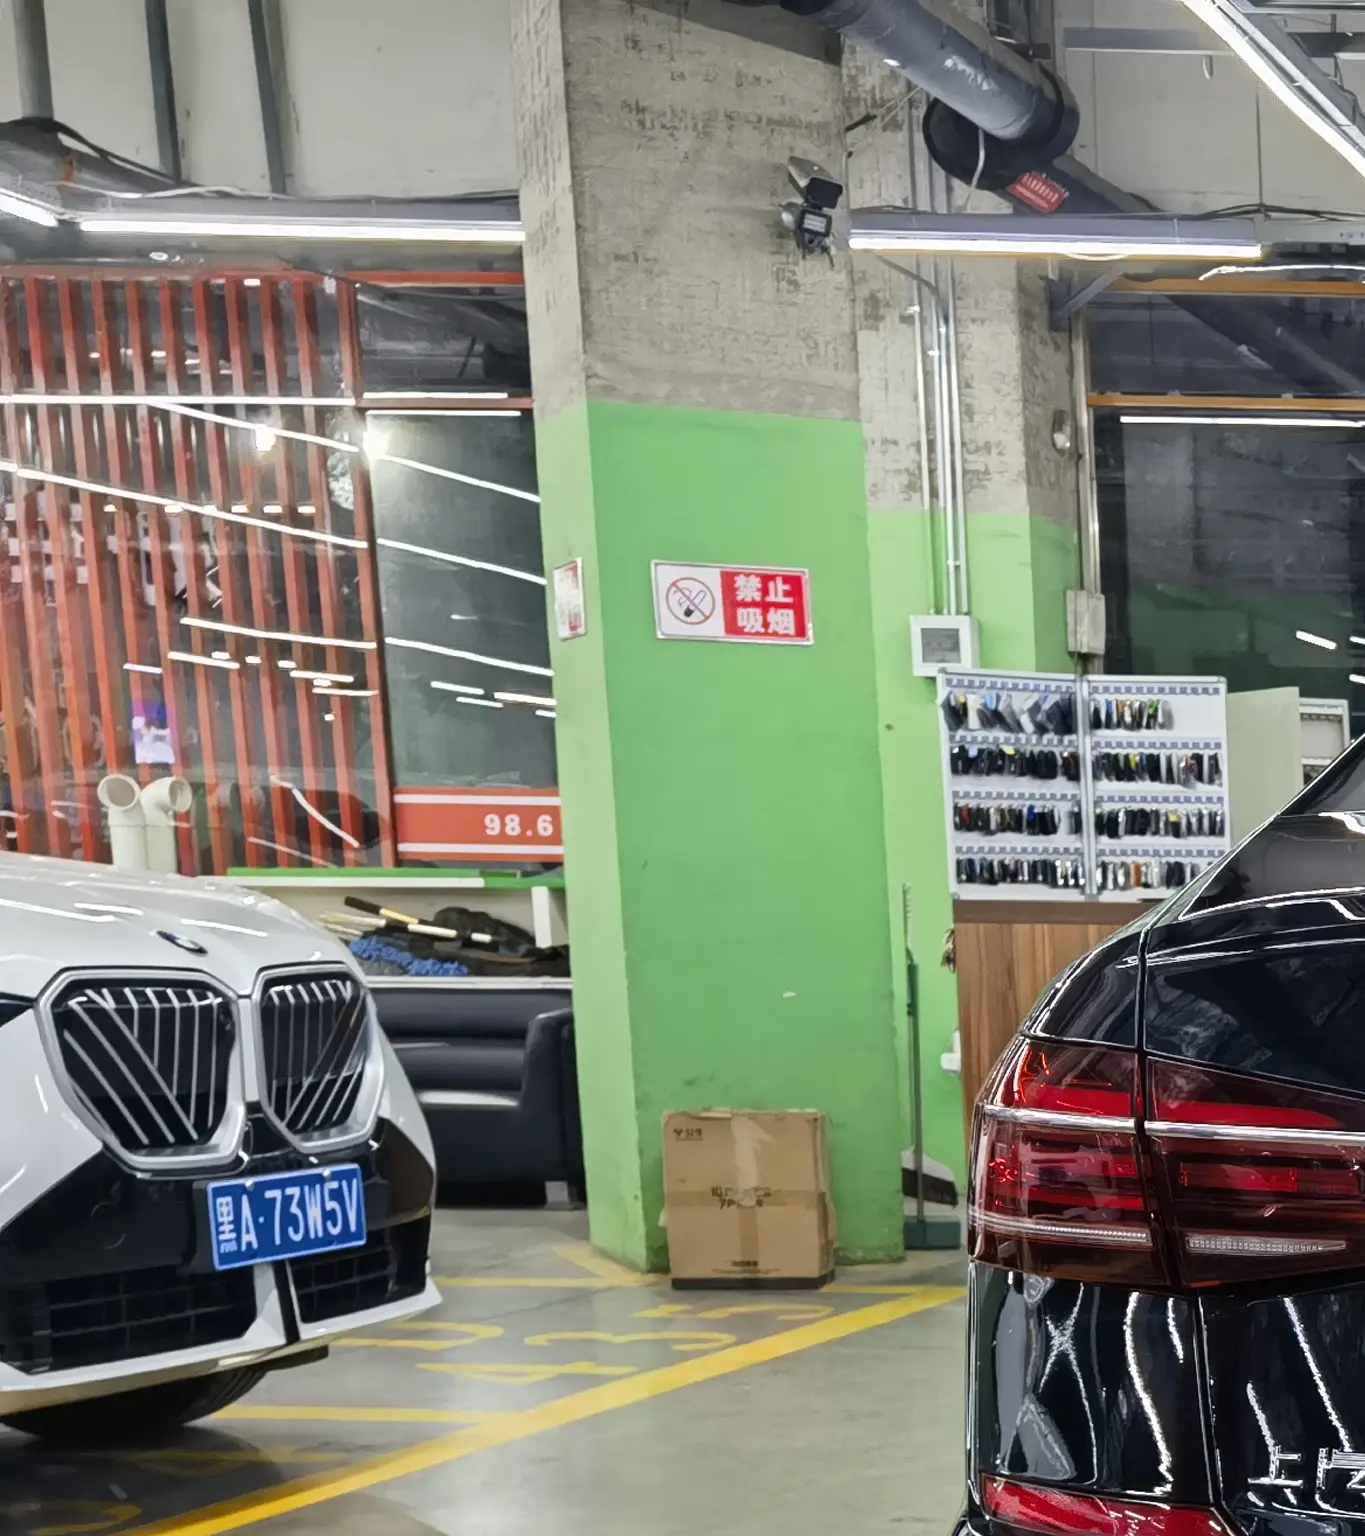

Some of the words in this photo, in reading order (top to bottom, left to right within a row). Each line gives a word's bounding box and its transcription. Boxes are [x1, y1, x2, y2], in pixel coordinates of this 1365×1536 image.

[734, 574, 793, 603] 禁止
[736, 607, 796, 636] 吸烟
[484, 813, 554, 836] 98.6
